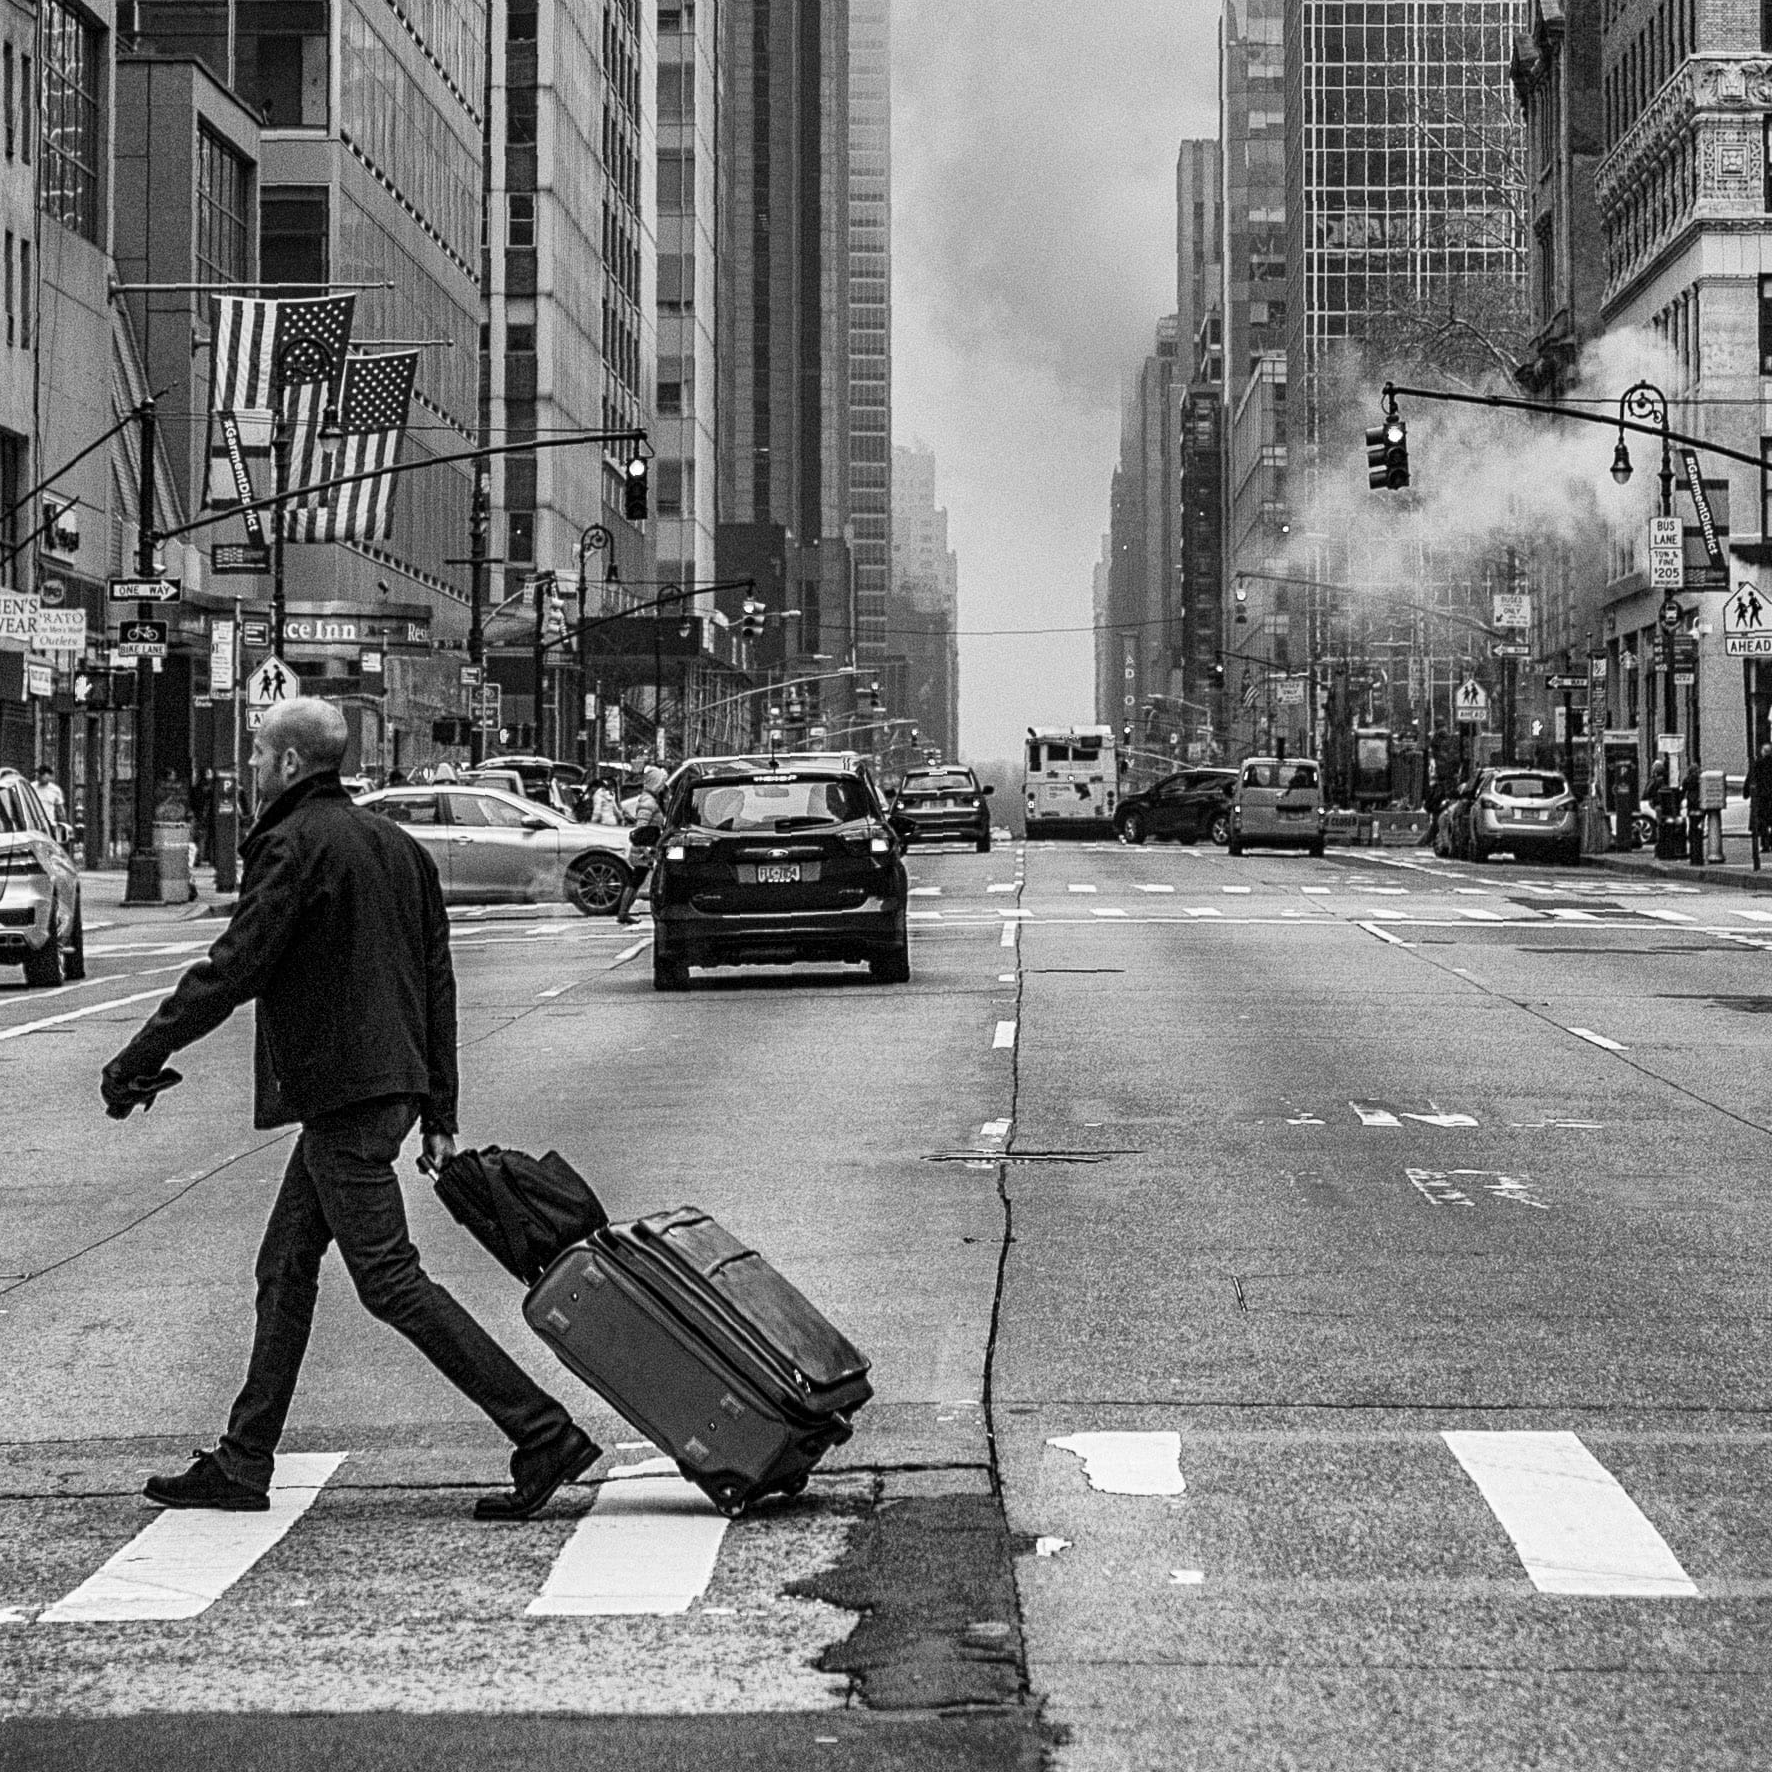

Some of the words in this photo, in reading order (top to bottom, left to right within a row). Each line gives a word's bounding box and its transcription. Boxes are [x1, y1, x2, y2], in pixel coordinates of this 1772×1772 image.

[223, 419, 259, 532] #GarmentDisrict
[1685, 456, 1719, 556] #GarmentDistrict
[1657, 520, 1675, 531] BUS
[1654, 534, 1678, 545] LANE
[1654, 568, 1680, 578] $205
[119, 586, 139, 596] ONE
[149, 586, 170, 596] WAY
[314, 621, 356, 640] Inn
[120, 645, 139, 653] BIKE
[142, 645, 165, 654] LANE
[1730, 640, 1772, 653] AHEAD
